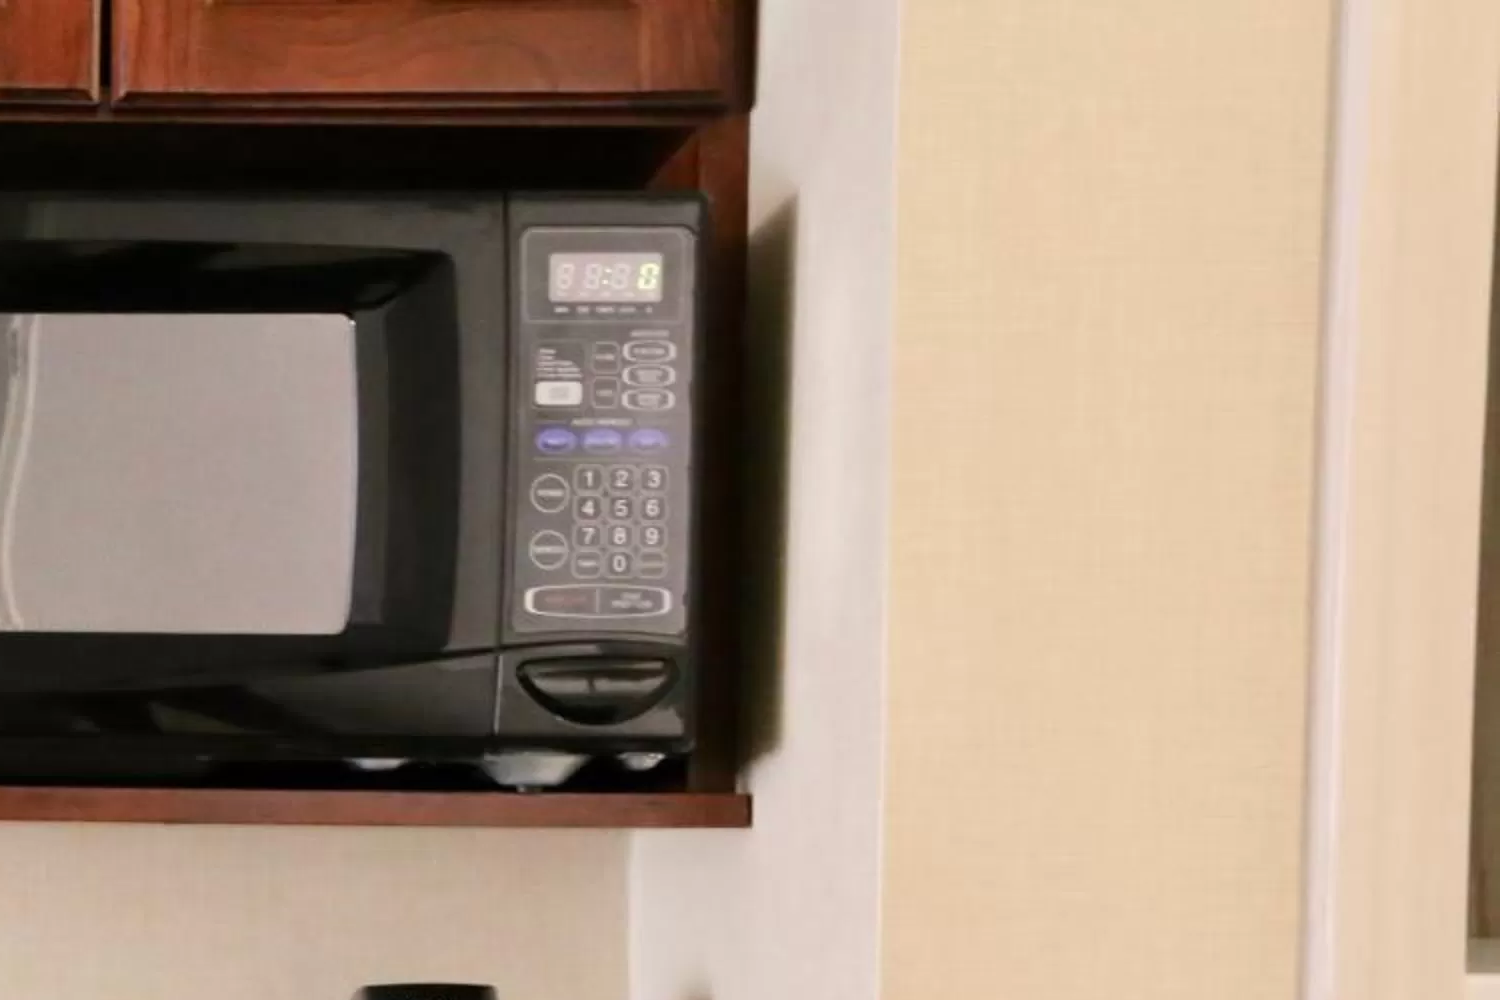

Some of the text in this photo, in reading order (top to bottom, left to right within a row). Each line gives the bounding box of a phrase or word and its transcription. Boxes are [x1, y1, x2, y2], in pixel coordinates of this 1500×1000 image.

[583, 470, 661, 488] 1 2 3
[581, 499, 660, 517] 4 5 6
[582, 527, 660, 545] 7 8 9
[612, 555, 626, 572] 0
